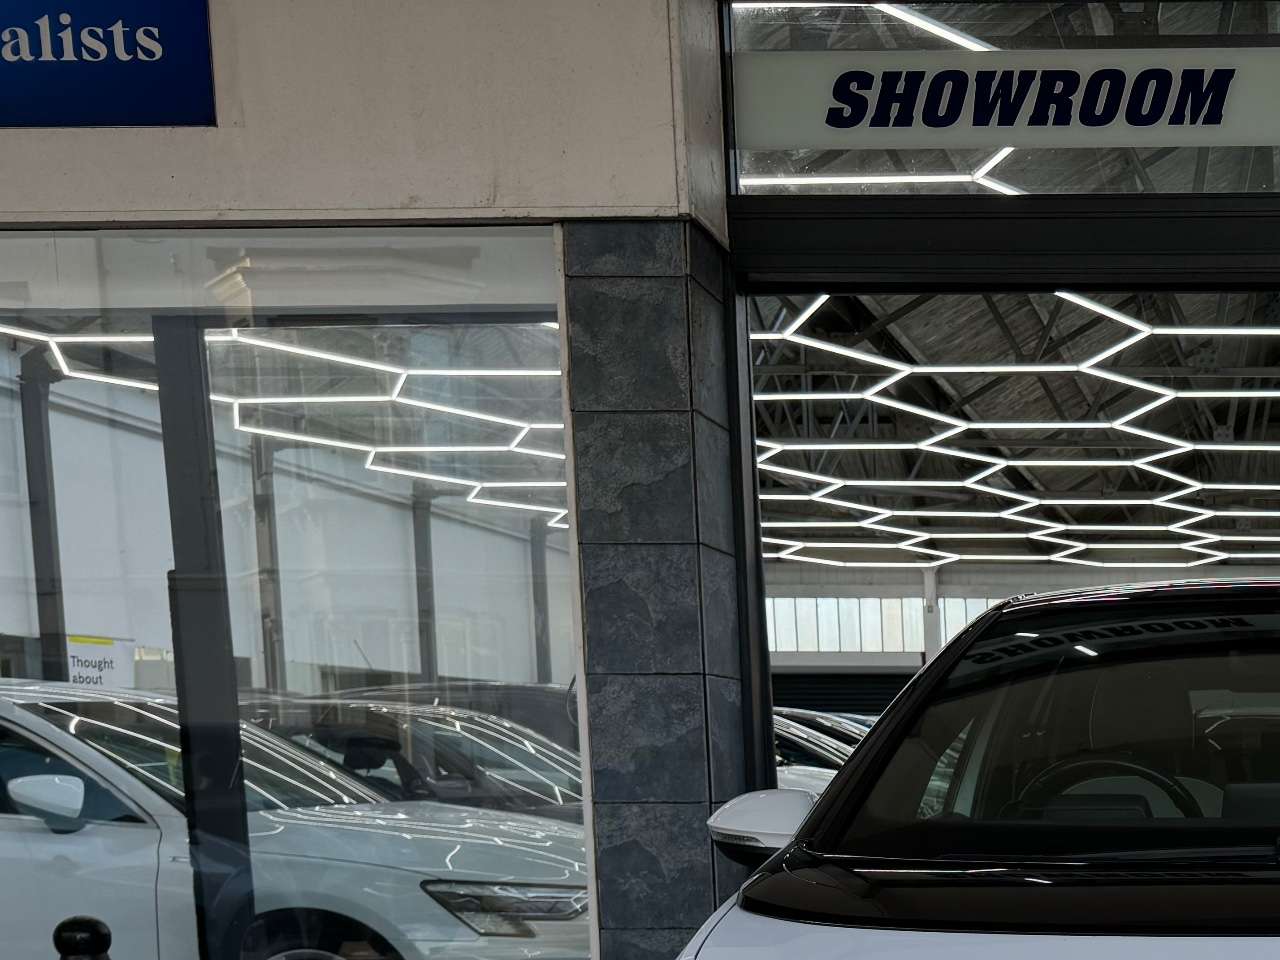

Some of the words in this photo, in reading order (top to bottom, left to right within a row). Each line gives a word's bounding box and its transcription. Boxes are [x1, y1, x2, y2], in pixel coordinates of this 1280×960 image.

[1, 13, 164, 62] alists
[825, 67, 1236, 129] SHOWROOM
[69, 655, 115, 672] Thought
[72, 673, 104, 686] about
